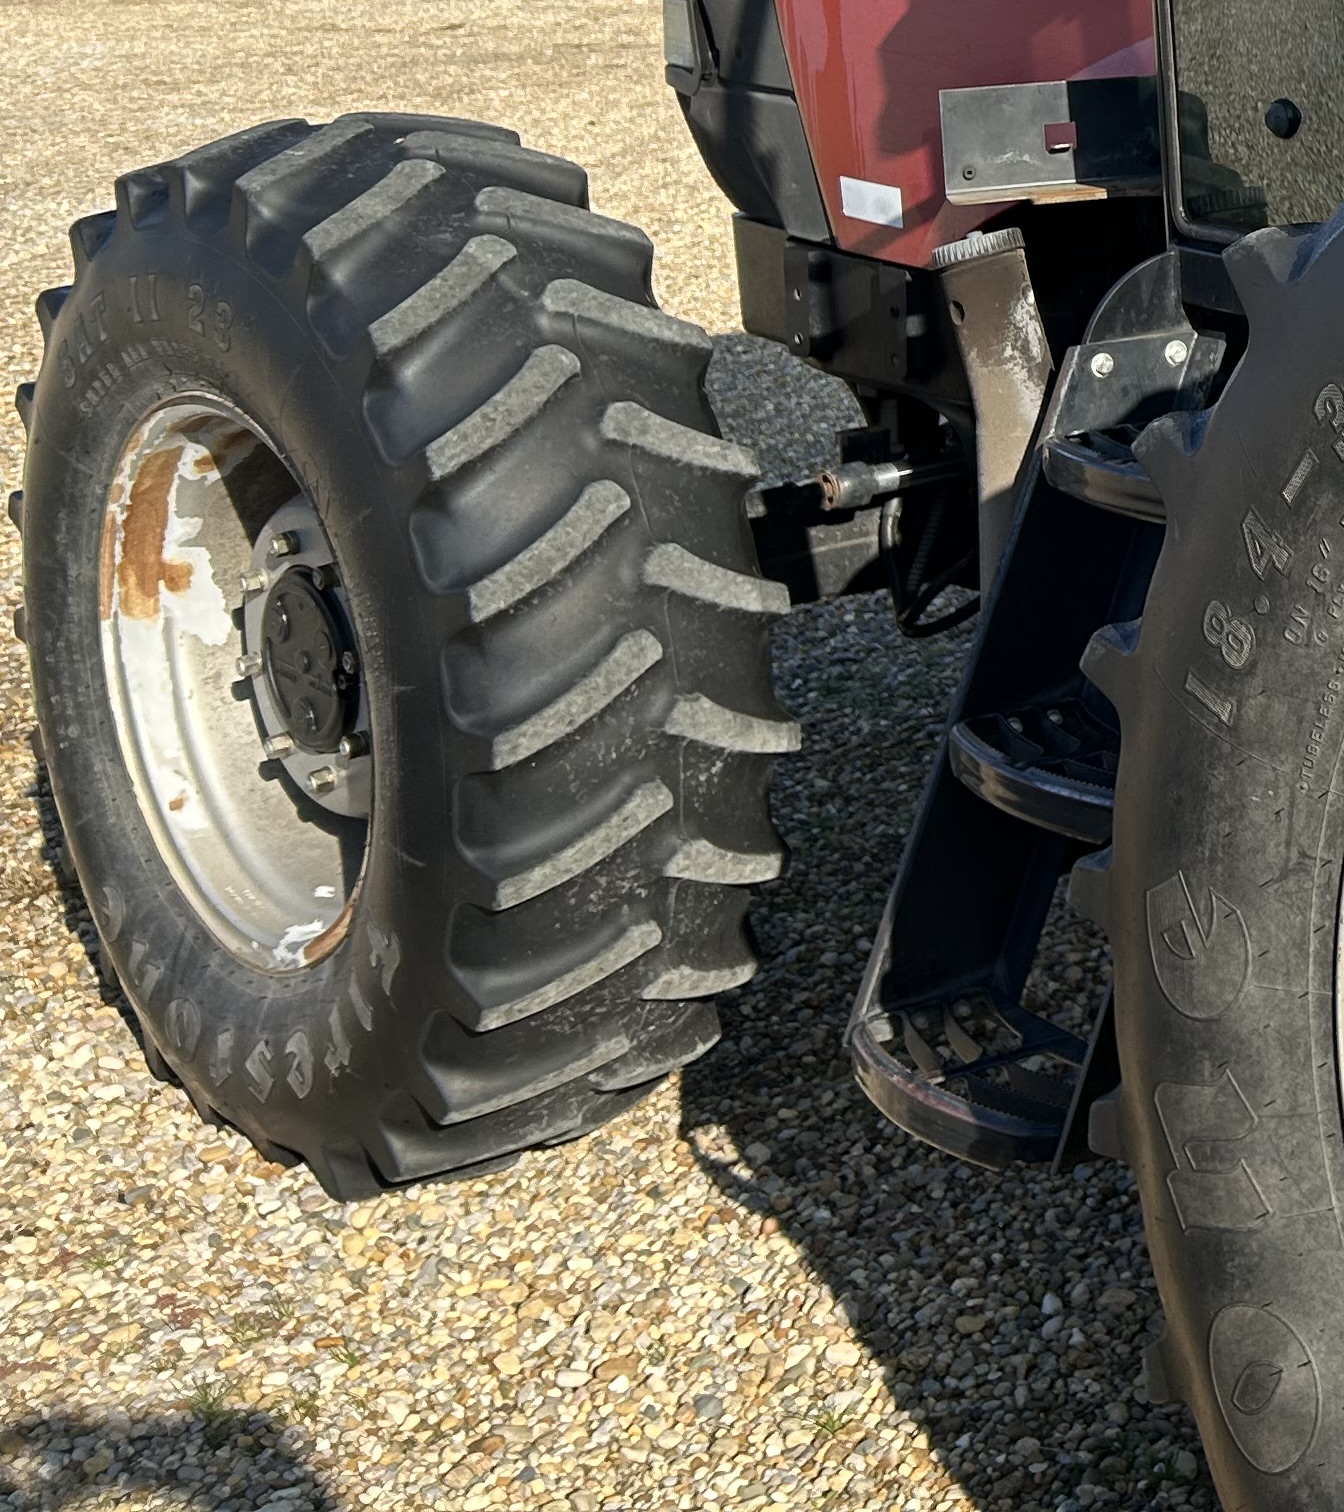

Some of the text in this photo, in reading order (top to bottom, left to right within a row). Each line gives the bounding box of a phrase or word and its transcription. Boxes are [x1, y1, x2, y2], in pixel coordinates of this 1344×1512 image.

[187, 284, 233, 353] 23
[1283, 604, 1312, 646] ON
[1300, 680, 1341, 783] TUBELESS
